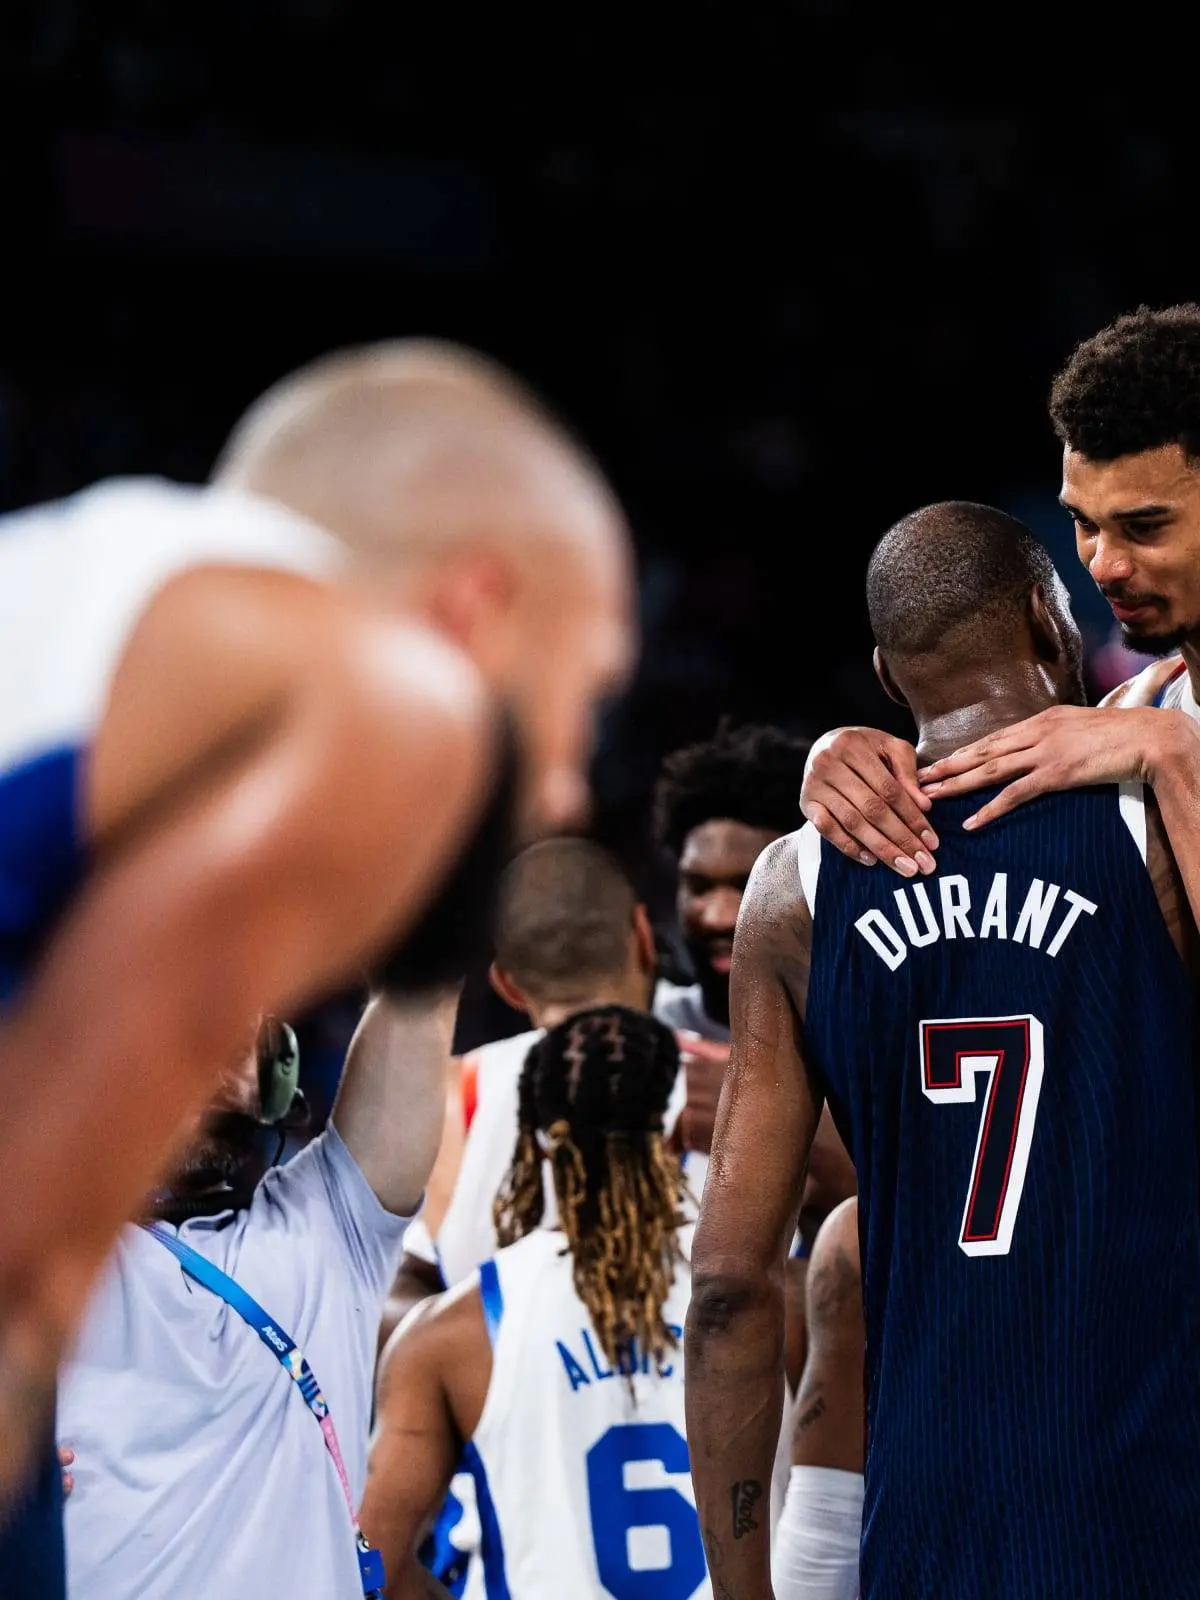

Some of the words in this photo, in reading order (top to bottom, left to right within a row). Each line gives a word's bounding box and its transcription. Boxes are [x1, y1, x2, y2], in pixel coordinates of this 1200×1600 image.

[854, 873, 1098, 971] DURANT
[919, 1013, 1044, 1257] 7
[586, 1423, 707, 1600] 6
